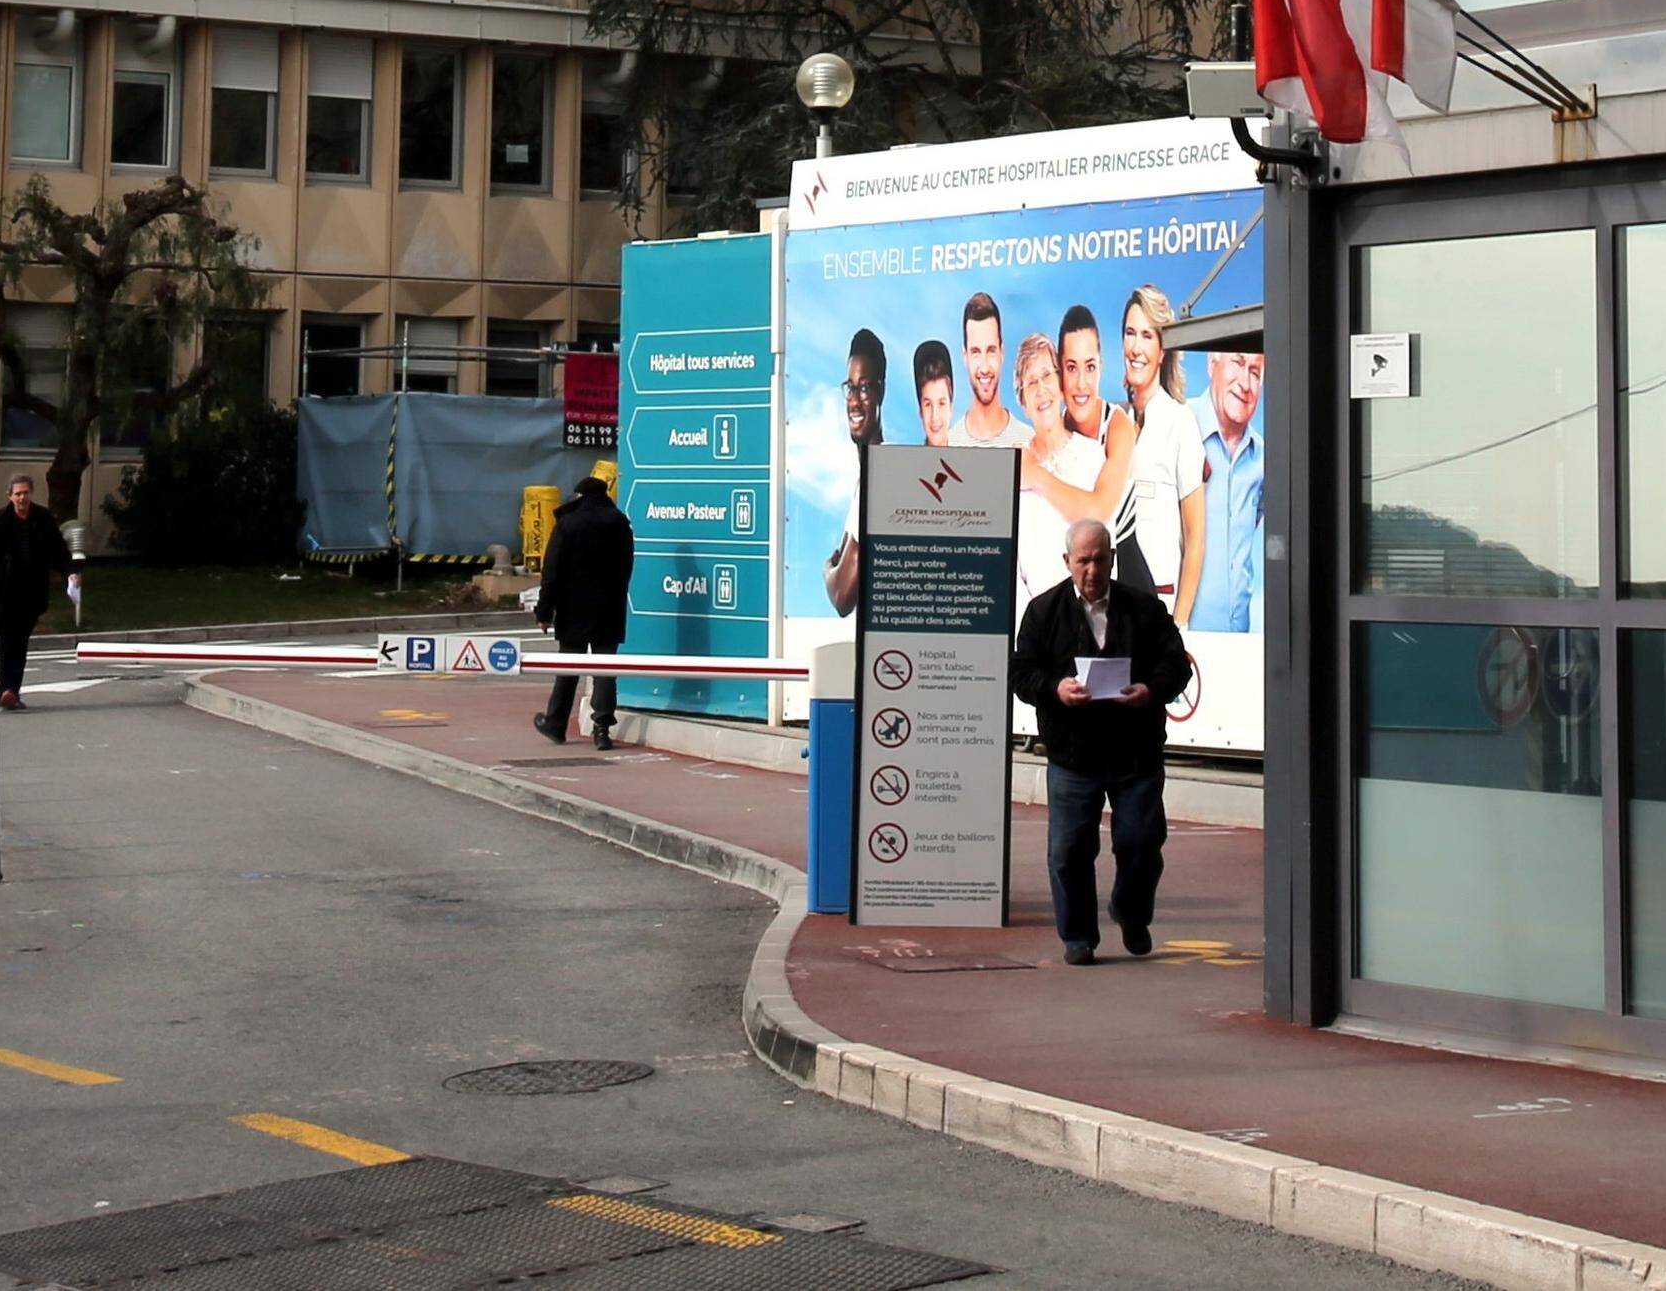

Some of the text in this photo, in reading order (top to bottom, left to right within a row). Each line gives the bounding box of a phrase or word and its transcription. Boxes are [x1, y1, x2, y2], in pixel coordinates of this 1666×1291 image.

[846, 141, 1230, 198] BIENVENUE AU CENTRE HOSPITALIER PRINCESSE GRACE
[823, 217, 1245, 280] ENSEMBLE, RESPECTONS NOTRE HÔPITAL
[650, 351, 755, 376] Hôpital tous services
[567, 424, 581, 434] 06
[567, 435, 581, 444] 06
[600, 437, 613, 446] 19
[668, 427, 708, 446] Accueil
[646, 502, 727, 520] Avenue Pasteur
[895, 508, 987, 518] CENTRE HOSPITALIER
[874, 543, 1001, 556] Vous entrez dans un hôpital.
[873, 558, 947, 569] Merci, par votre
[873, 571, 984, 581] comportement et votre
[663, 576, 708, 598] Cap d'Ail
[873, 581, 985, 593] discrétion, de respecter
[886, 593, 904, 601] lieu
[905, 593, 934, 602] dédié
[934, 595, 953, 603] aux
[954, 594, 995, 604] patients,
[886, 604, 935, 615] personnel
[936, 605, 977, 616] soignant
[978, 606, 989, 614] et
[871, 614, 972, 627] à la qualité des soins.
[412, 639, 432, 662] P
[491, 647, 515, 655] ROULEZ
[918, 649, 956, 660] Hôpital
[496, 661, 509, 669] PAS
[918, 662, 975, 672] sans tabac
[916, 711, 983, 721] Nos amis les
[916, 724, 977, 733] animaux ne
[916, 736, 995, 746] sont pas admis
[915, 768, 960, 780] Engins à
[914, 782, 963, 791] roulettes
[914, 793, 958, 803] interdits
[913, 832, 996, 843] Jeux de ballons
[913, 844, 957, 854] interdits
